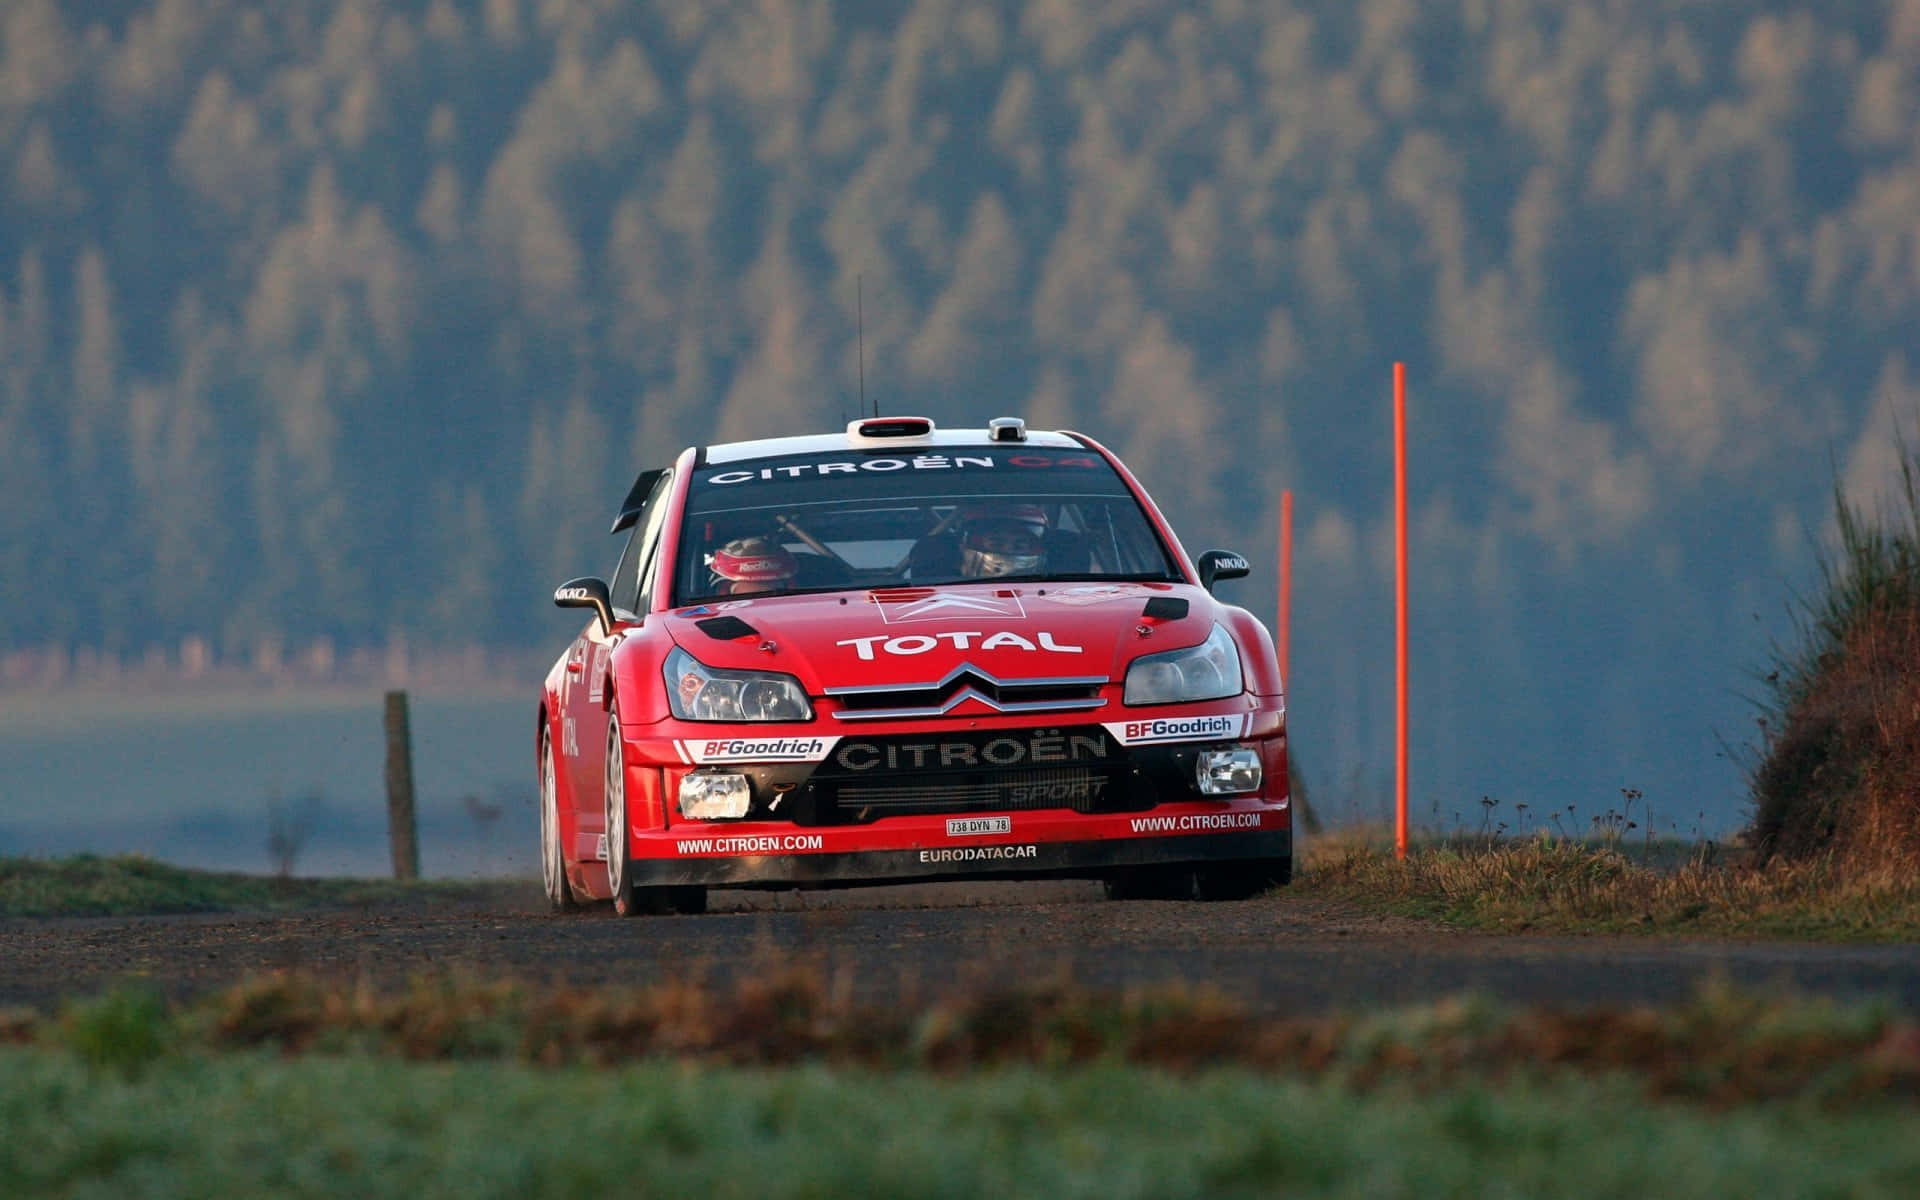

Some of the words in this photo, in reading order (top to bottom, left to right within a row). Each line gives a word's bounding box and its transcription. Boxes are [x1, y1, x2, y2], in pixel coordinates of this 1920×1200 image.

[708, 455, 994, 485] CITROËN
[1007, 455, 1097, 469] C4
[1214, 558, 1249, 569] NIKKO
[836, 631, 1083, 661] TOTAL
[1125, 717, 1232, 738] BFGoodrich
[704, 739, 823, 756] BFGoodrich
[836, 729, 1107, 771] CITROËN
[1010, 782, 1105, 802] SPORT
[950, 821, 967, 833] 738
[970, 820, 990, 832] DYN
[995, 819, 1007, 831] 78
[1130, 813, 1261, 832] WWW.CITROEN.COM
[677, 836, 823, 854] WWW.CITROEN.COM
[919, 845, 1037, 863] EURODATACAR
